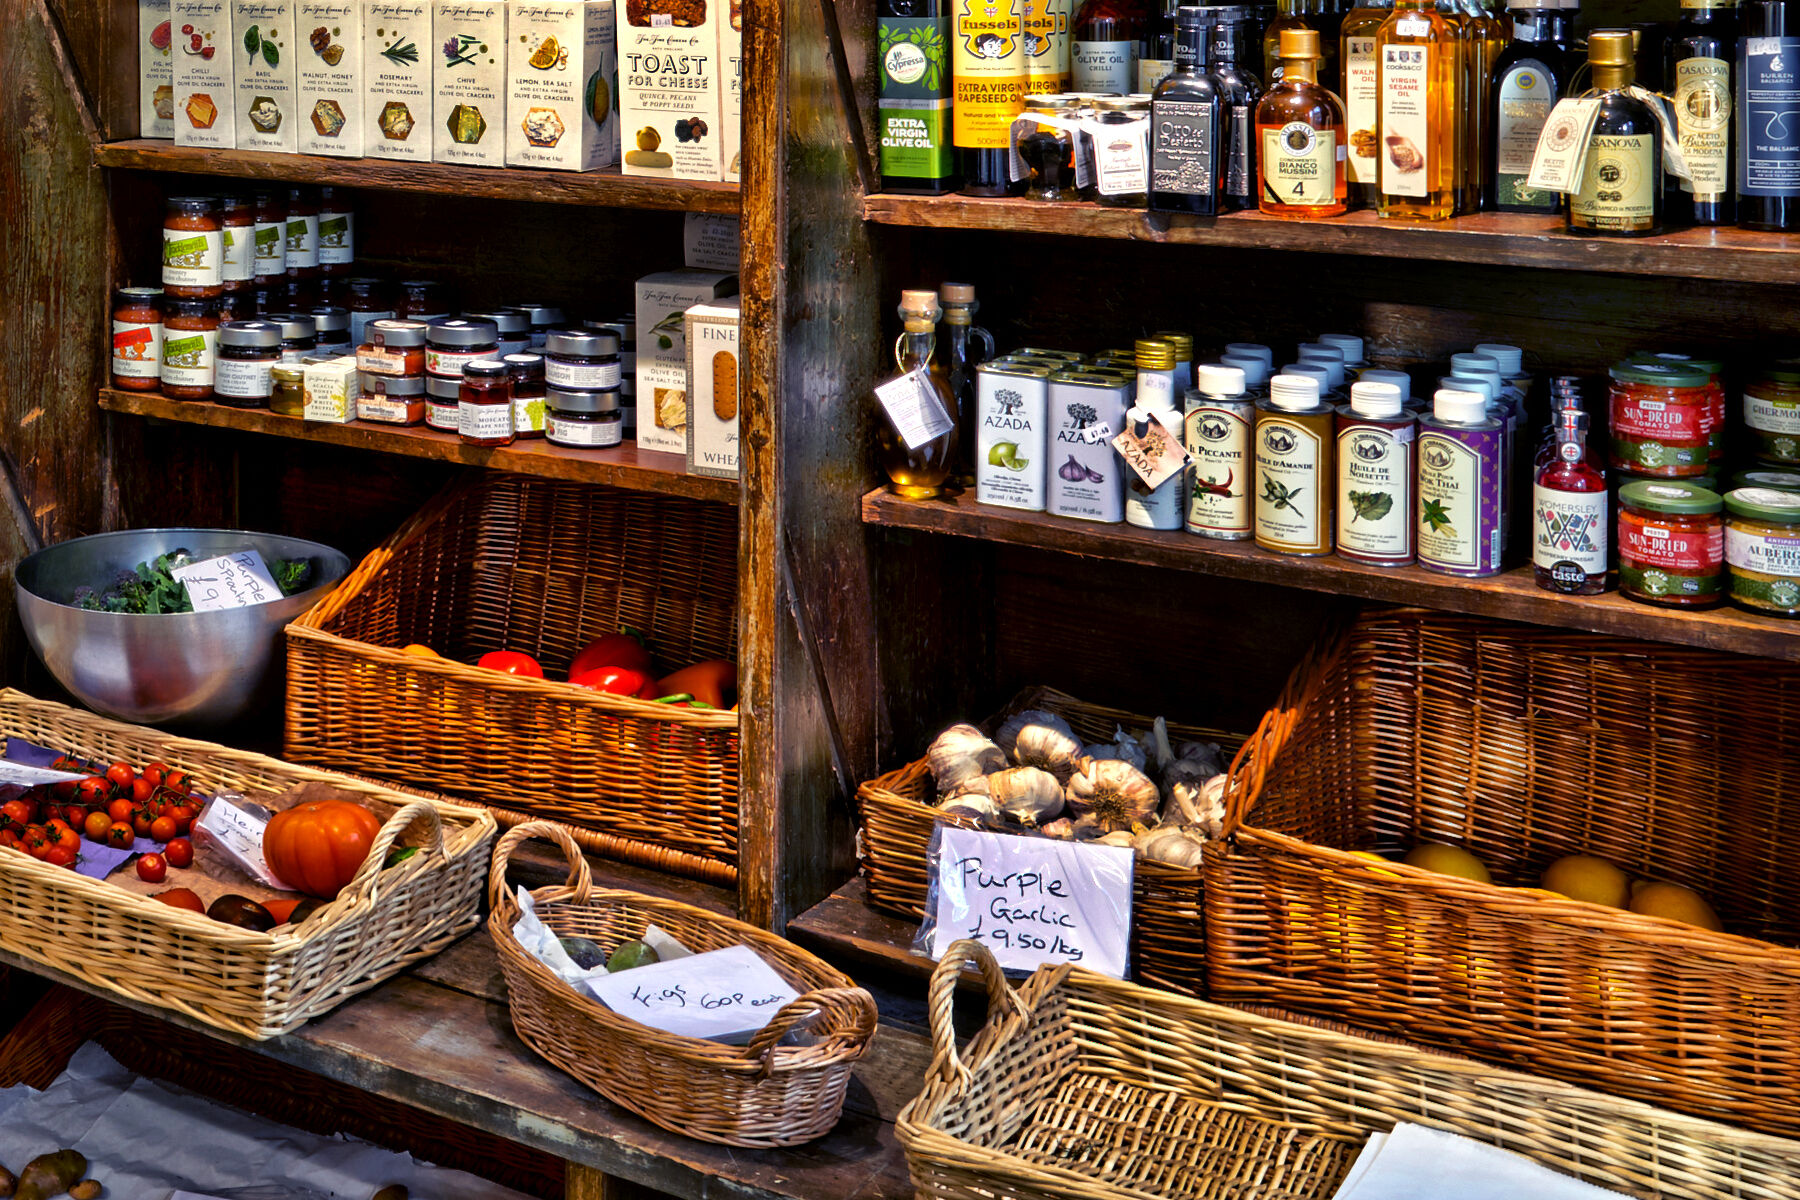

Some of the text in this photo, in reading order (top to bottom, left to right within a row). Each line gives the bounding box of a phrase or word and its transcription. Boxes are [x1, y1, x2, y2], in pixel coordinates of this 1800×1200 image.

[962, 19, 1017, 30] fussels
[626, 53, 708, 75] TOAST
[887, 55, 925, 76] Cypressa
[627, 76, 708, 89] FOR CHEESE
[639, 92, 667, 101] QUINCE,
[649, 101, 670, 109] POPPY
[887, 118, 926, 129] EXTRA
[887, 128, 928, 138] VIRGIN
[881, 138, 934, 149] OLIVE OIL
[1292, 182, 1304, 197] 4
[703, 327, 736, 340] FINE
[1624, 407, 1683, 424] SUN-DRIED
[985, 416, 1032, 432] AZADA
[1634, 421, 1670, 430] TOMATO
[1538, 501, 1597, 514] WOMERSLEY
[1552, 572, 1584, 583] taste
[956, 857, 1069, 897] Purple
[990, 897, 1076, 929] Garlic
[751, 994, 786, 1008] each
